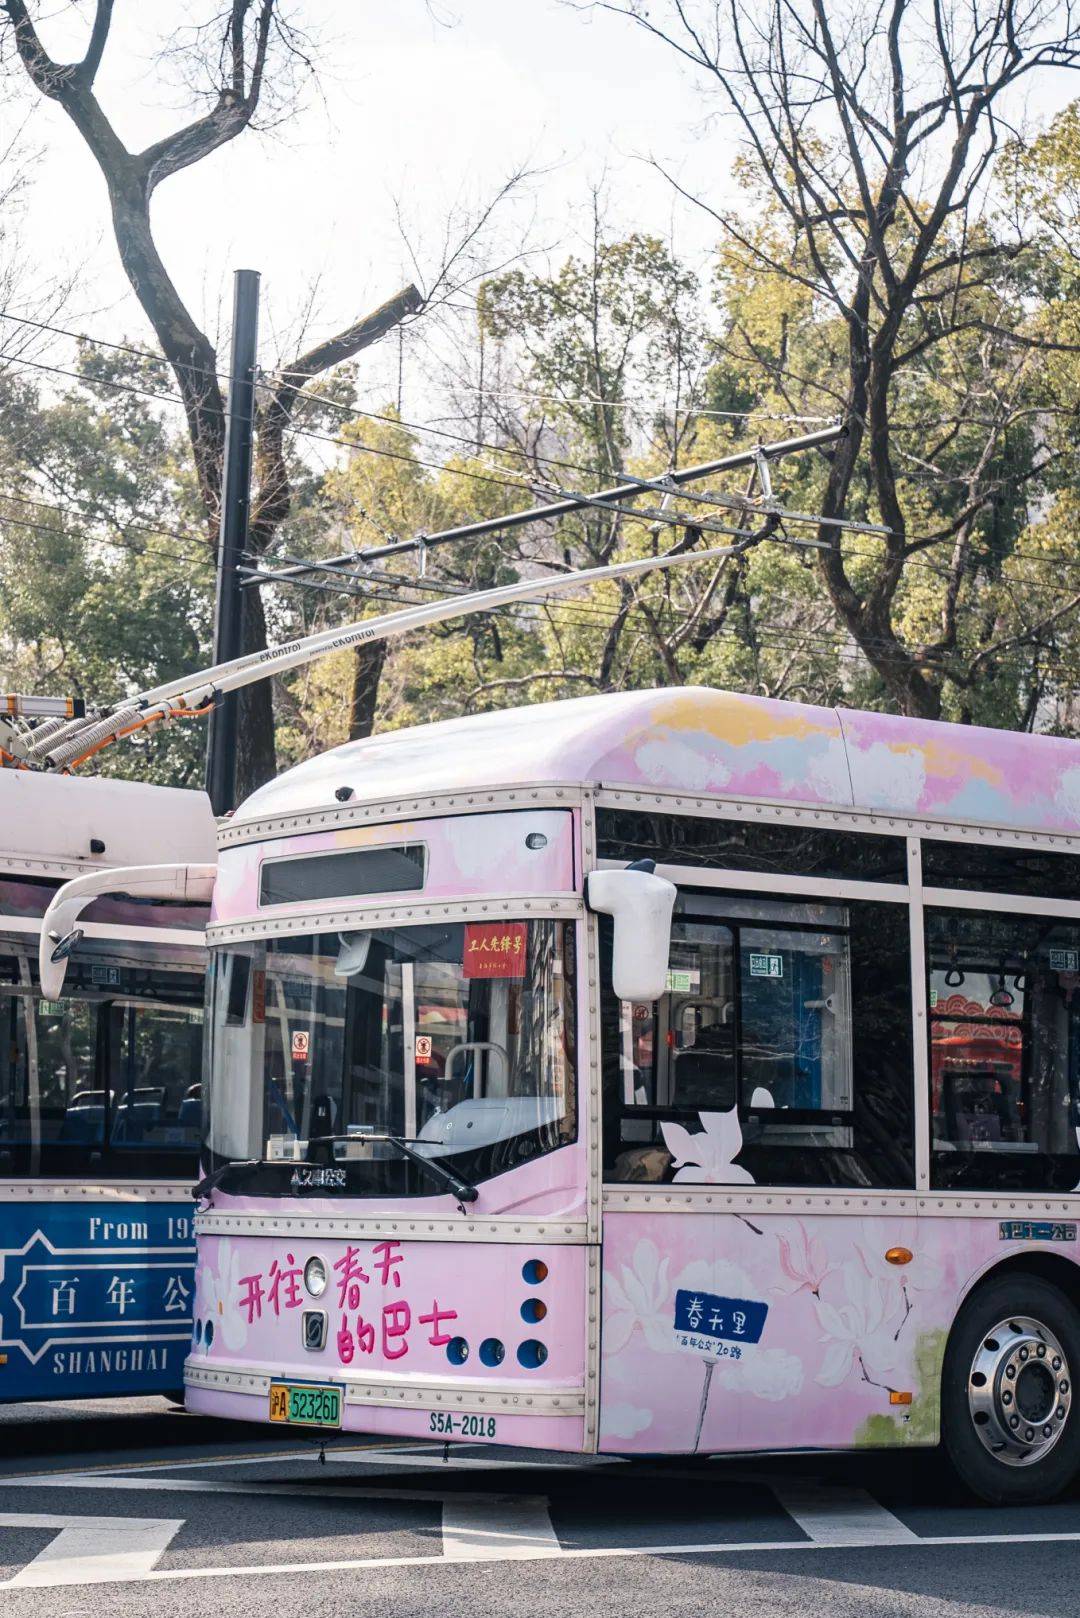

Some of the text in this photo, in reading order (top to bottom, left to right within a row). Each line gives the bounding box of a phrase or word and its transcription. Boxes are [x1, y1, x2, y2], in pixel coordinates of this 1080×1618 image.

[468, 935, 522, 956] 工人先锋号
[90, 1217, 148, 1240] From
[685, 1296, 746, 1335] 春天里
[337, 1300, 458, 1364] 的巴士
[53, 1349, 167, 1374] SHANGHAI
[429, 1412, 496, 1438] S5A-2018
